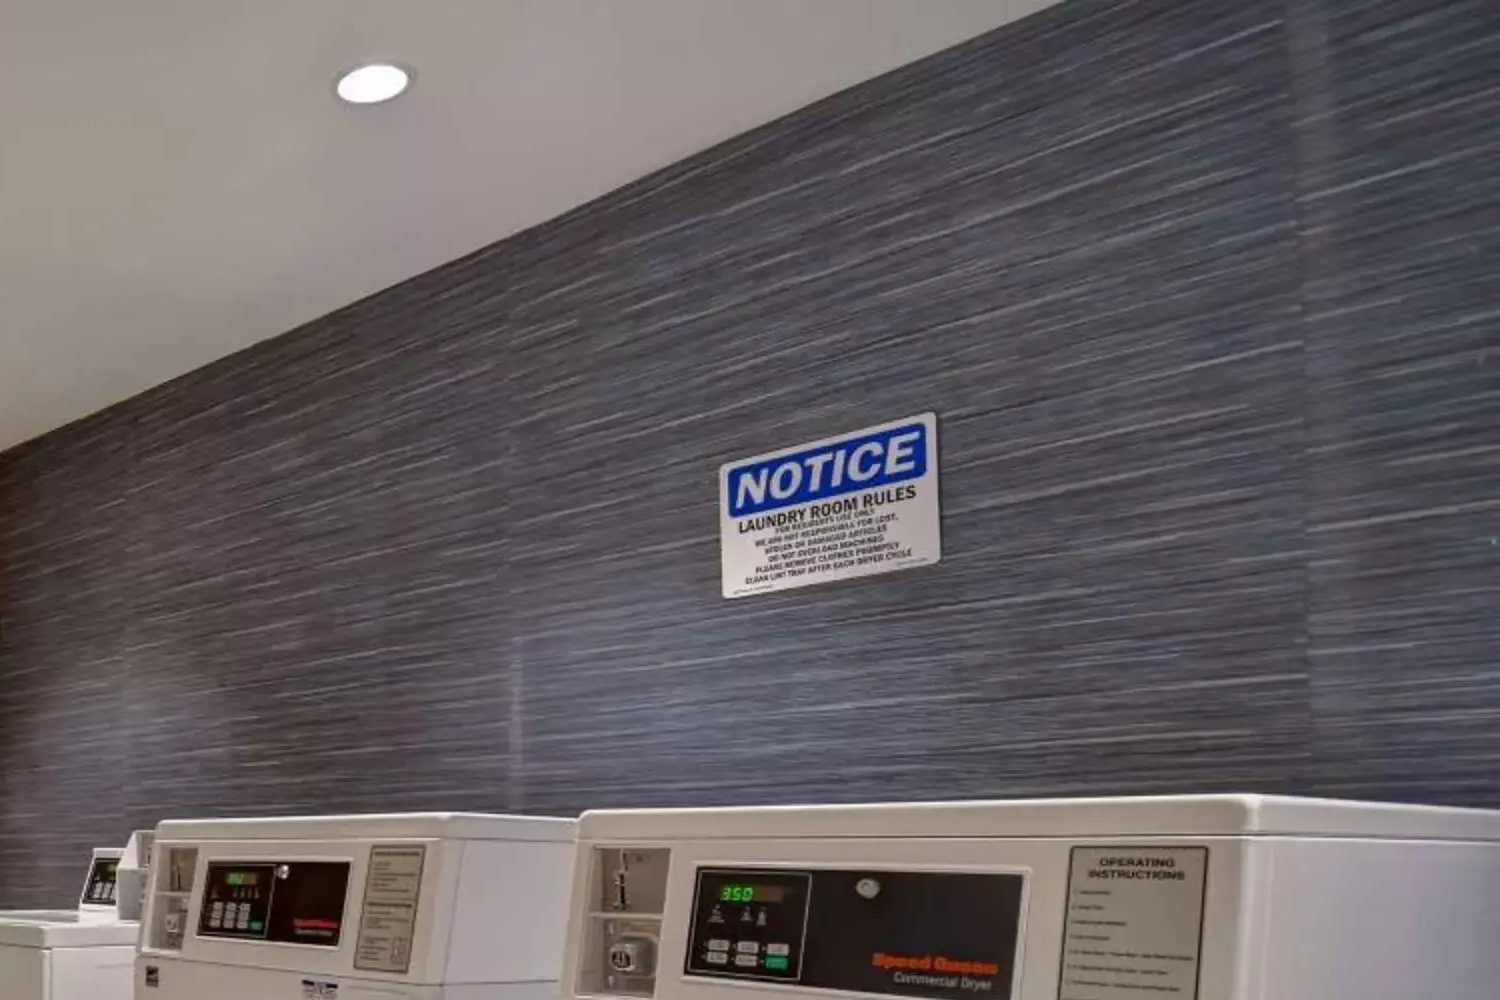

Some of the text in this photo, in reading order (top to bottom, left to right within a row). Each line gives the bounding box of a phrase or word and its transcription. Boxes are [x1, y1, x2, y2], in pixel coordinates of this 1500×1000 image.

[735, 431, 920, 509] NOTICE
[739, 485, 917, 534] LAUNDRY ROOM RULES
[1099, 857, 1175, 868] OPERATING
[1088, 869, 1185, 881] INSTRUCTIONS
[893, 971, 992, 992] Commercial Dryer
